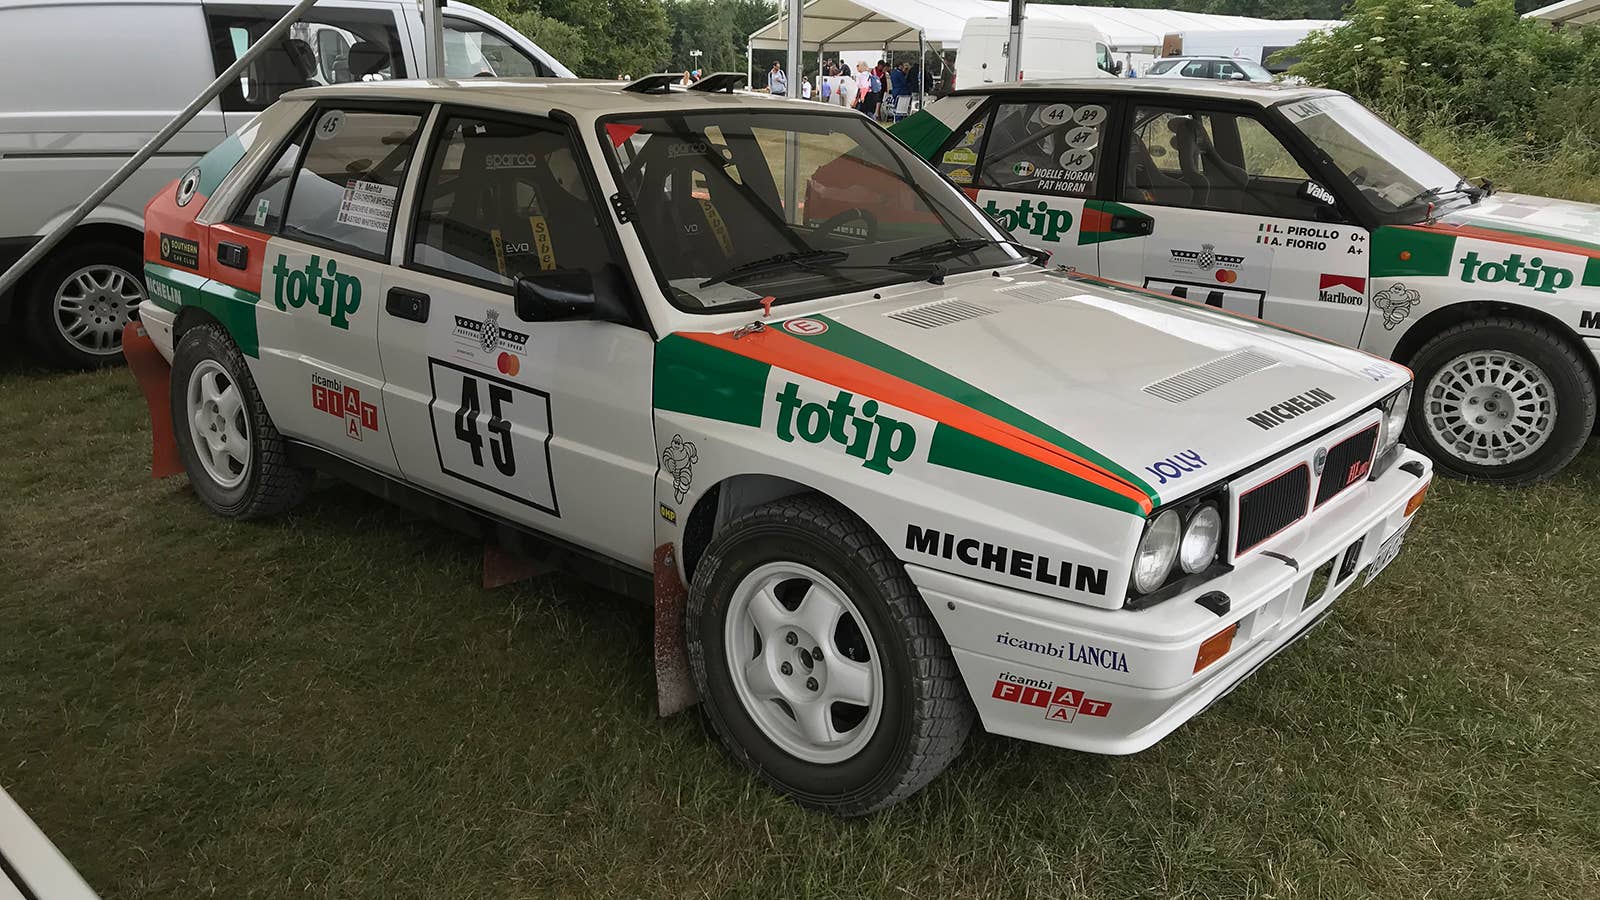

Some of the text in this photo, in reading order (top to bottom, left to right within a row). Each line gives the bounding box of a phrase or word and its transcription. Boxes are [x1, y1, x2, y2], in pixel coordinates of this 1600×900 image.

[1048, 109, 1065, 120] 44
[322, 117, 338, 133] 45
[485, 153, 537, 169] sparco
[1033, 168, 1096, 182] NOELLE HORAN
[365, 183, 383, 194] Mehta
[1038, 180, 1086, 193] PAT HORAN
[1306, 182, 1335, 205] Valeo
[1273, 225, 1283, 234] L.
[1287, 226, 1340, 240] PIROLLO
[171, 240, 198, 254] SOUTHERN
[1270, 237, 1363, 255] A. FIORIO A+
[1459, 251, 1574, 294] totip
[272, 253, 362, 330] totip
[1318, 290, 1364, 307] Marlboro
[500, 330, 526, 343] WOOD
[311, 372, 342, 392] ricambi
[313, 388, 377, 427] FIAT
[1246, 387, 1337, 431] MICHELIN
[455, 375, 516, 478] 45
[775, 381, 917, 476] totip
[1144, 449, 1208, 485] JOLLY
[661, 506, 676, 521] OMP
[905, 523, 1109, 596] MICHELIN
[996, 632, 1130, 673] ricambi LANCIA
[999, 671, 1053, 690] ricambi
[997, 683, 1107, 715] FIAT
